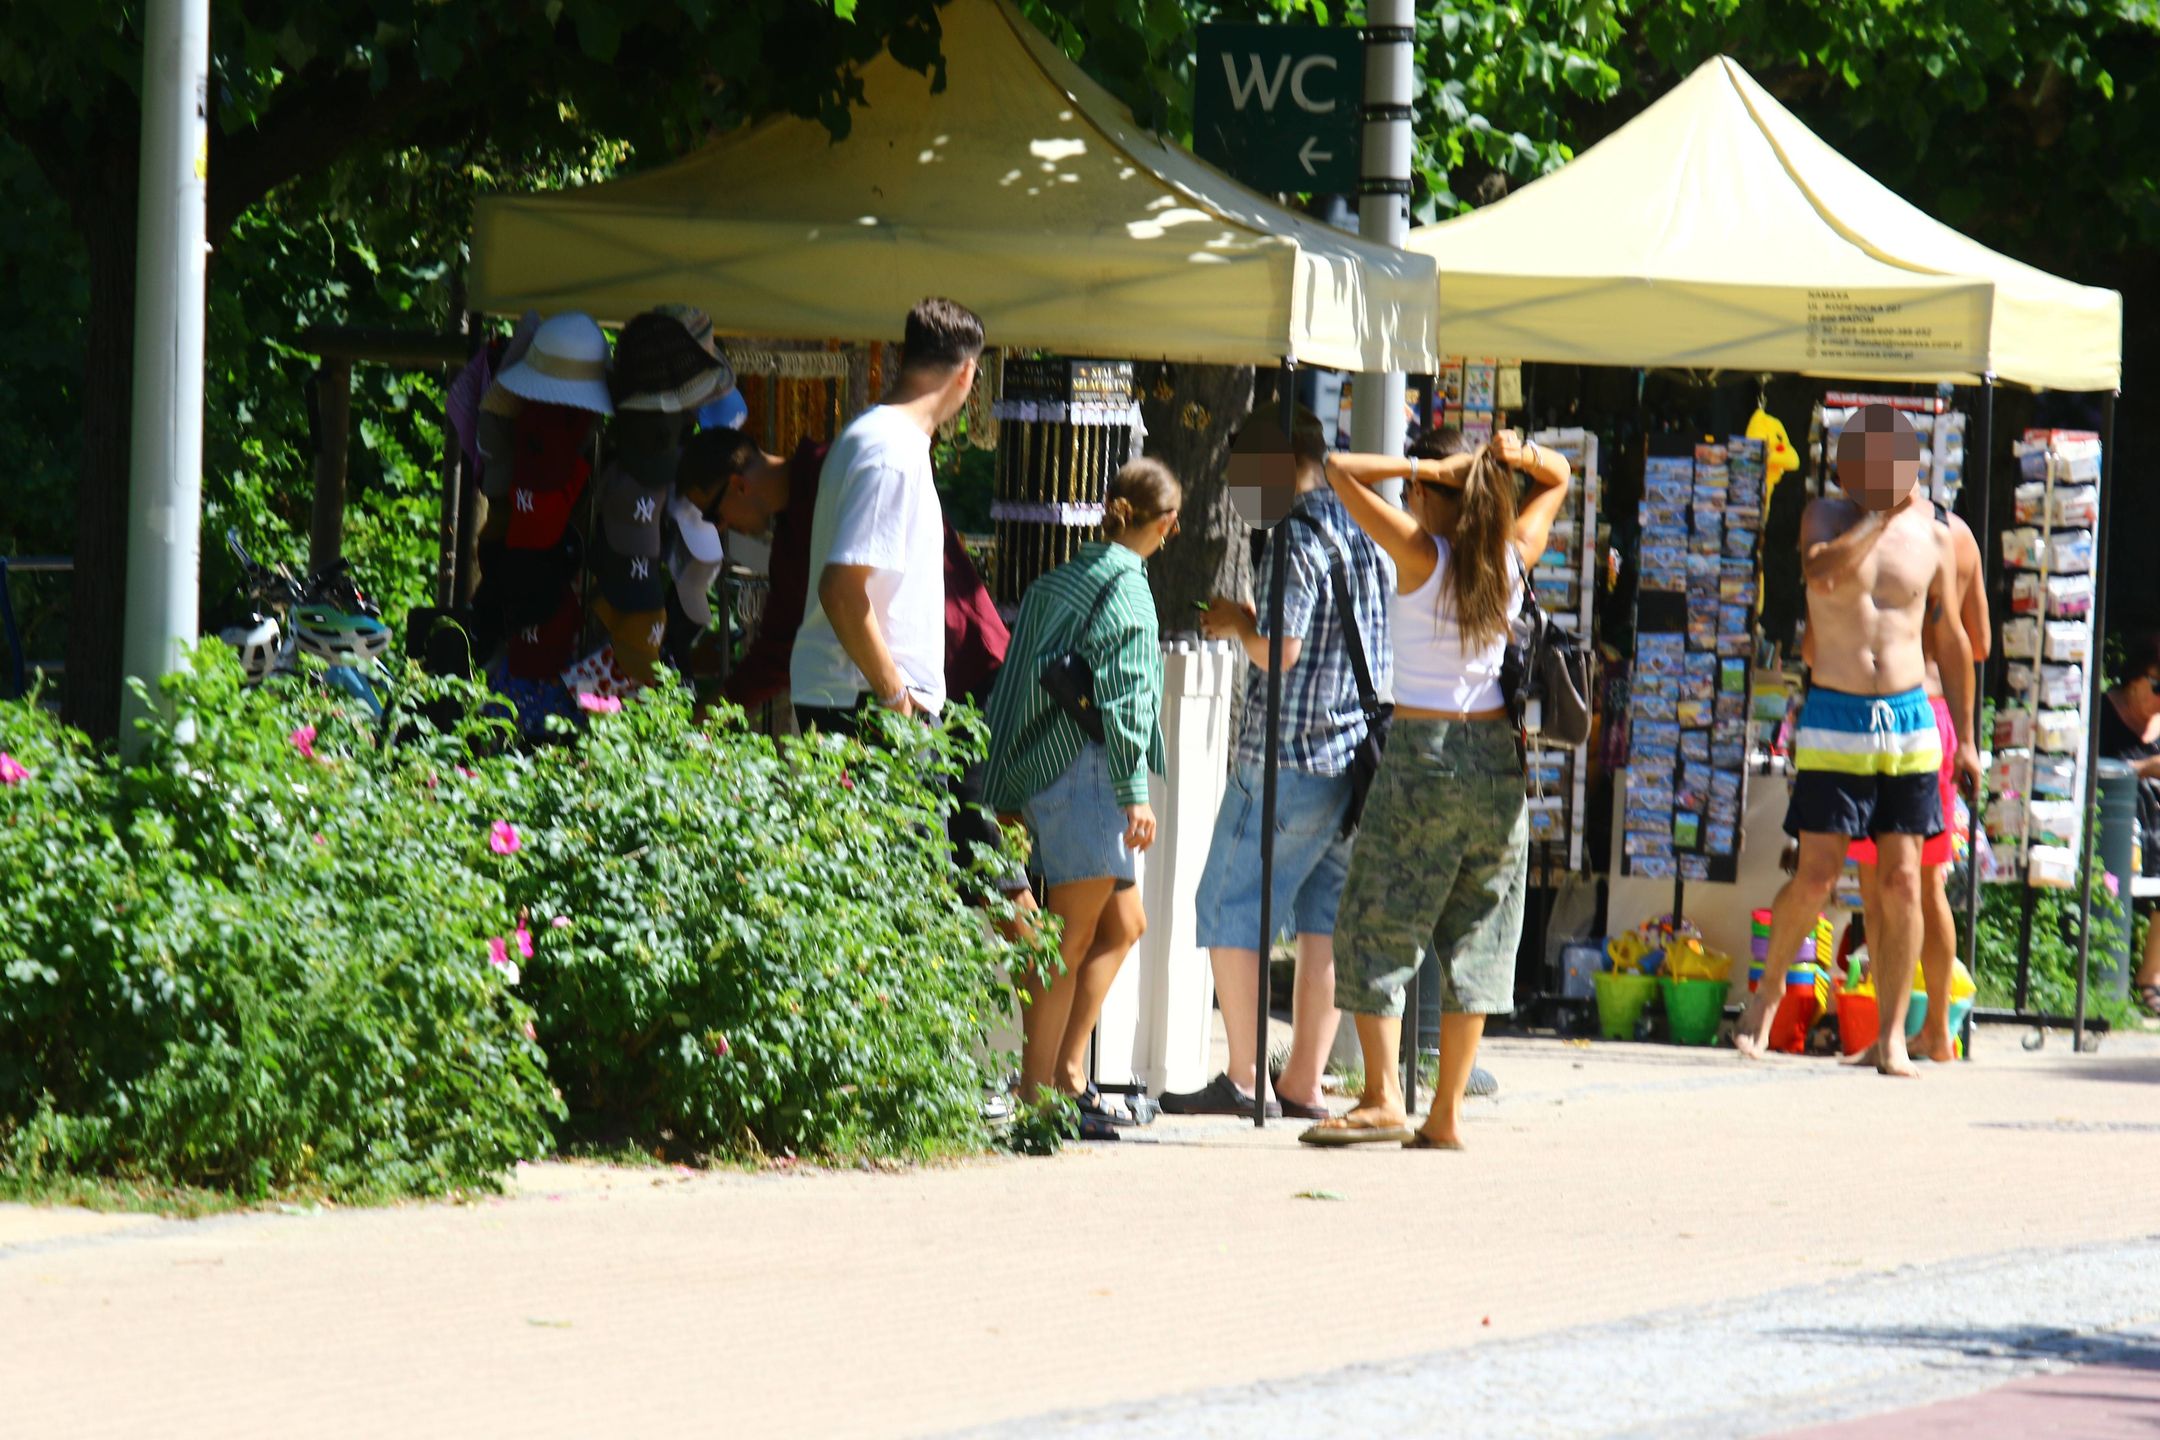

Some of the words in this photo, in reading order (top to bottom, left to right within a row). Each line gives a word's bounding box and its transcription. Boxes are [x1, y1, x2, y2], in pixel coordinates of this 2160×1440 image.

[1221, 52, 1338, 114] WC
[633, 495, 656, 523] NY
[630, 555, 649, 580] NY
